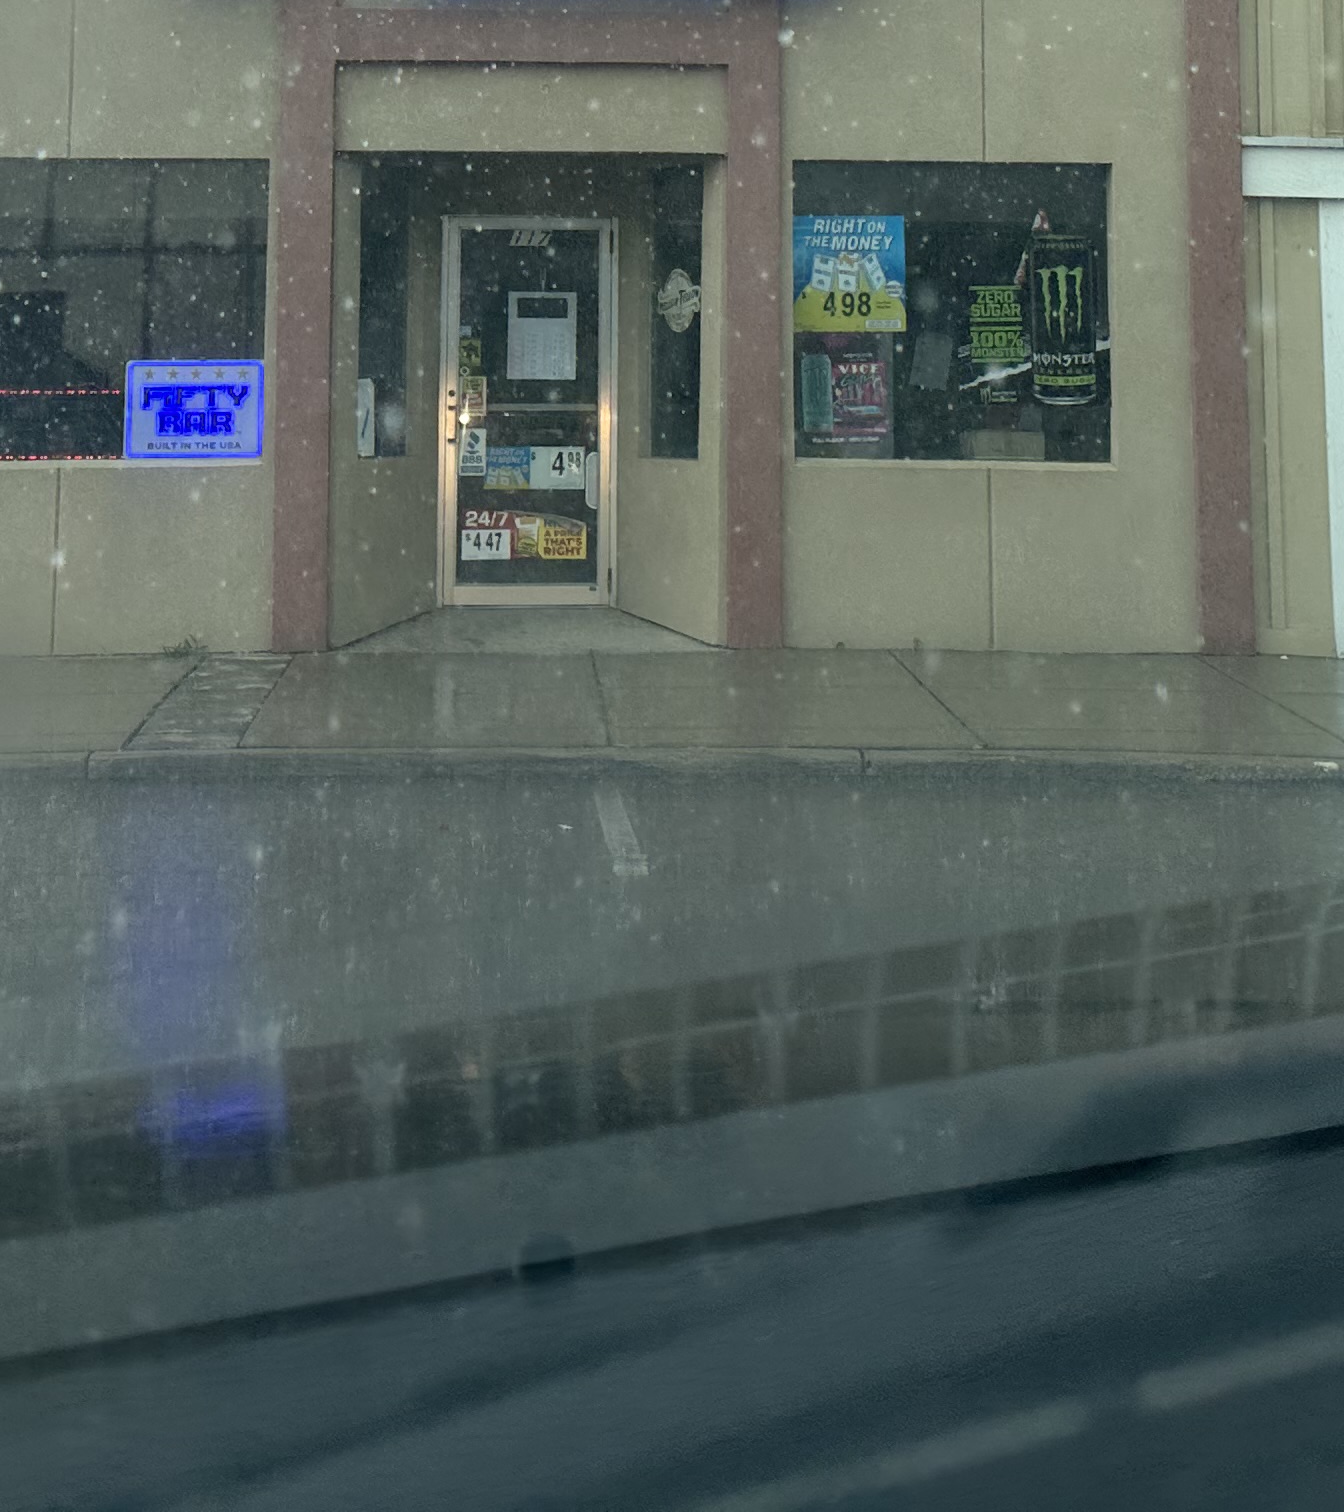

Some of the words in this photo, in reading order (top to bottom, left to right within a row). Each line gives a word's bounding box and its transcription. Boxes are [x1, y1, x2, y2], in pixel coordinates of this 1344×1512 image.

[814, 218, 866, 234] RIGHT
[867, 221, 886, 233] ON
[804, 235, 830, 247] THE
[830, 236, 893, 250] MONEY
[976, 291, 1013, 303] ZERO
[970, 303, 1021, 317] SUGAR
[971, 331, 1023, 347] 100%
[971, 348, 1024, 358] MONSTER
[158, 410, 233, 434] BAR
[196, 441, 216, 450] THE
[220, 441, 242, 450] USA
[465, 510, 509, 526] 24/7
[543, 547, 582, 556] RIGHT
